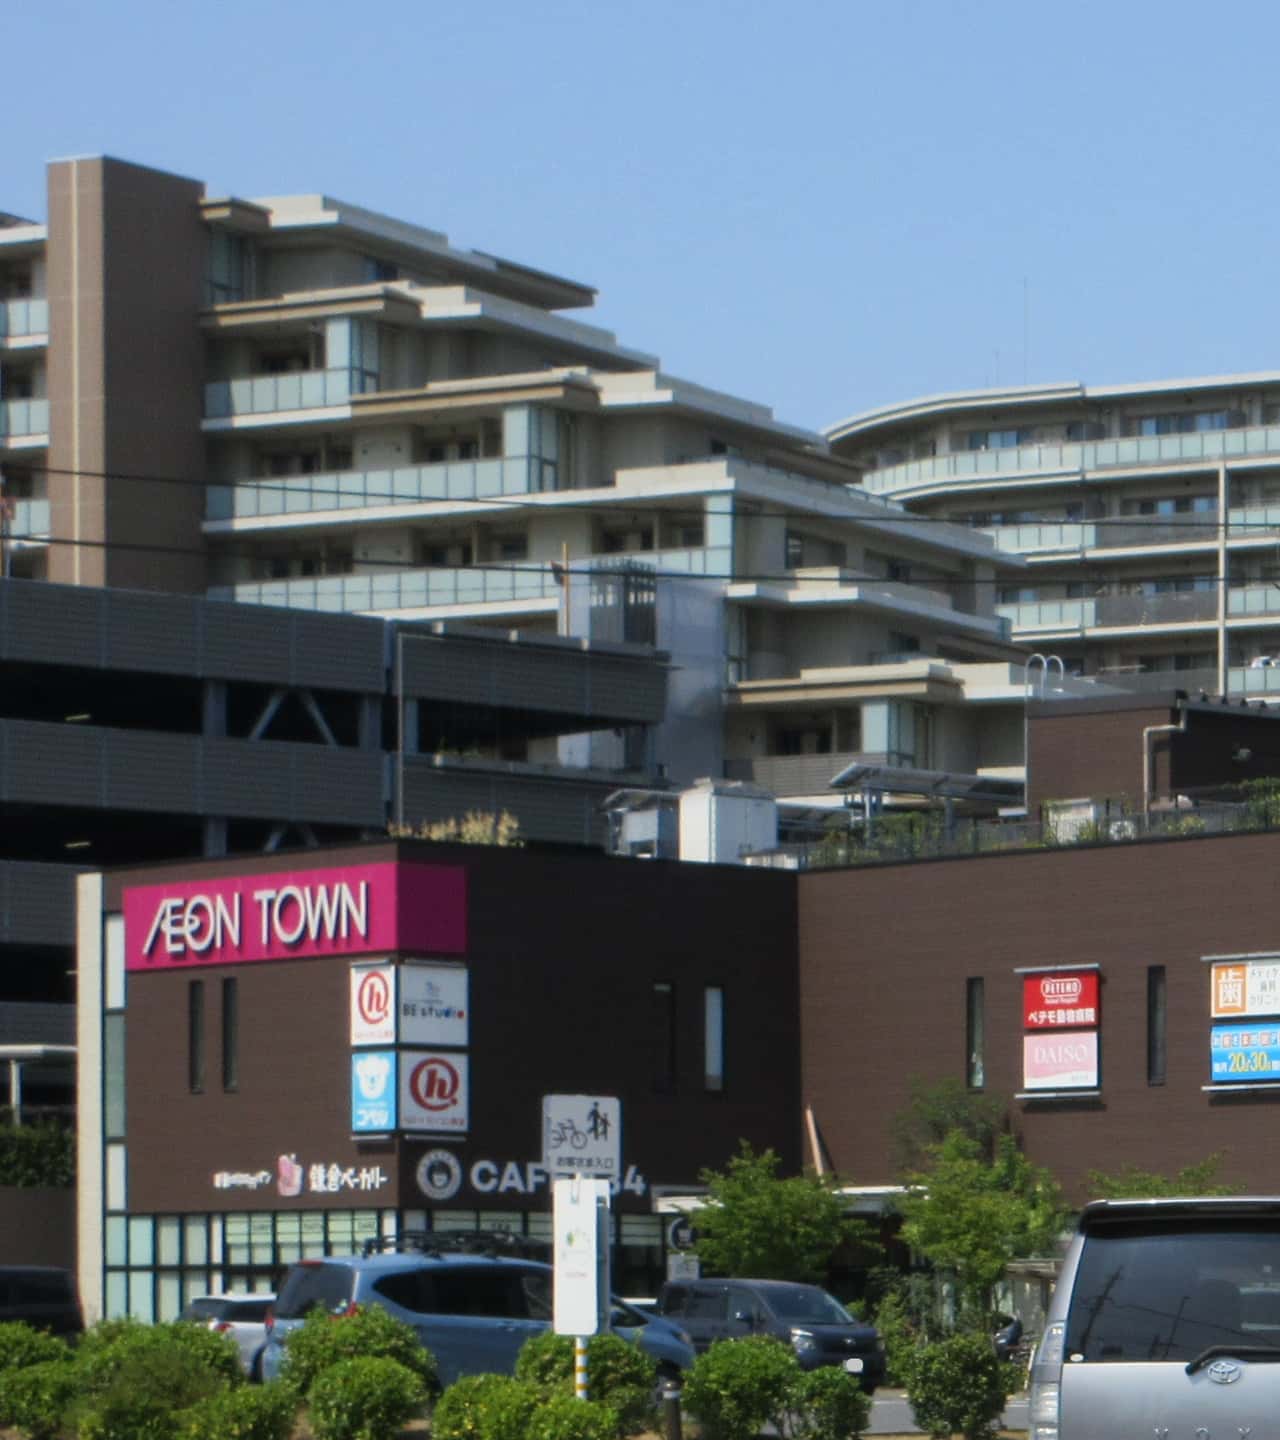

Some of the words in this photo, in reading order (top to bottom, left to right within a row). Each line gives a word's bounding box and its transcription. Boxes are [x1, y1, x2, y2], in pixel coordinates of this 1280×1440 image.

[254, 881, 367, 946] TOWN
[1217, 965, 1244, 1009] 歯
[1033, 1042, 1088, 1065] DAISO
